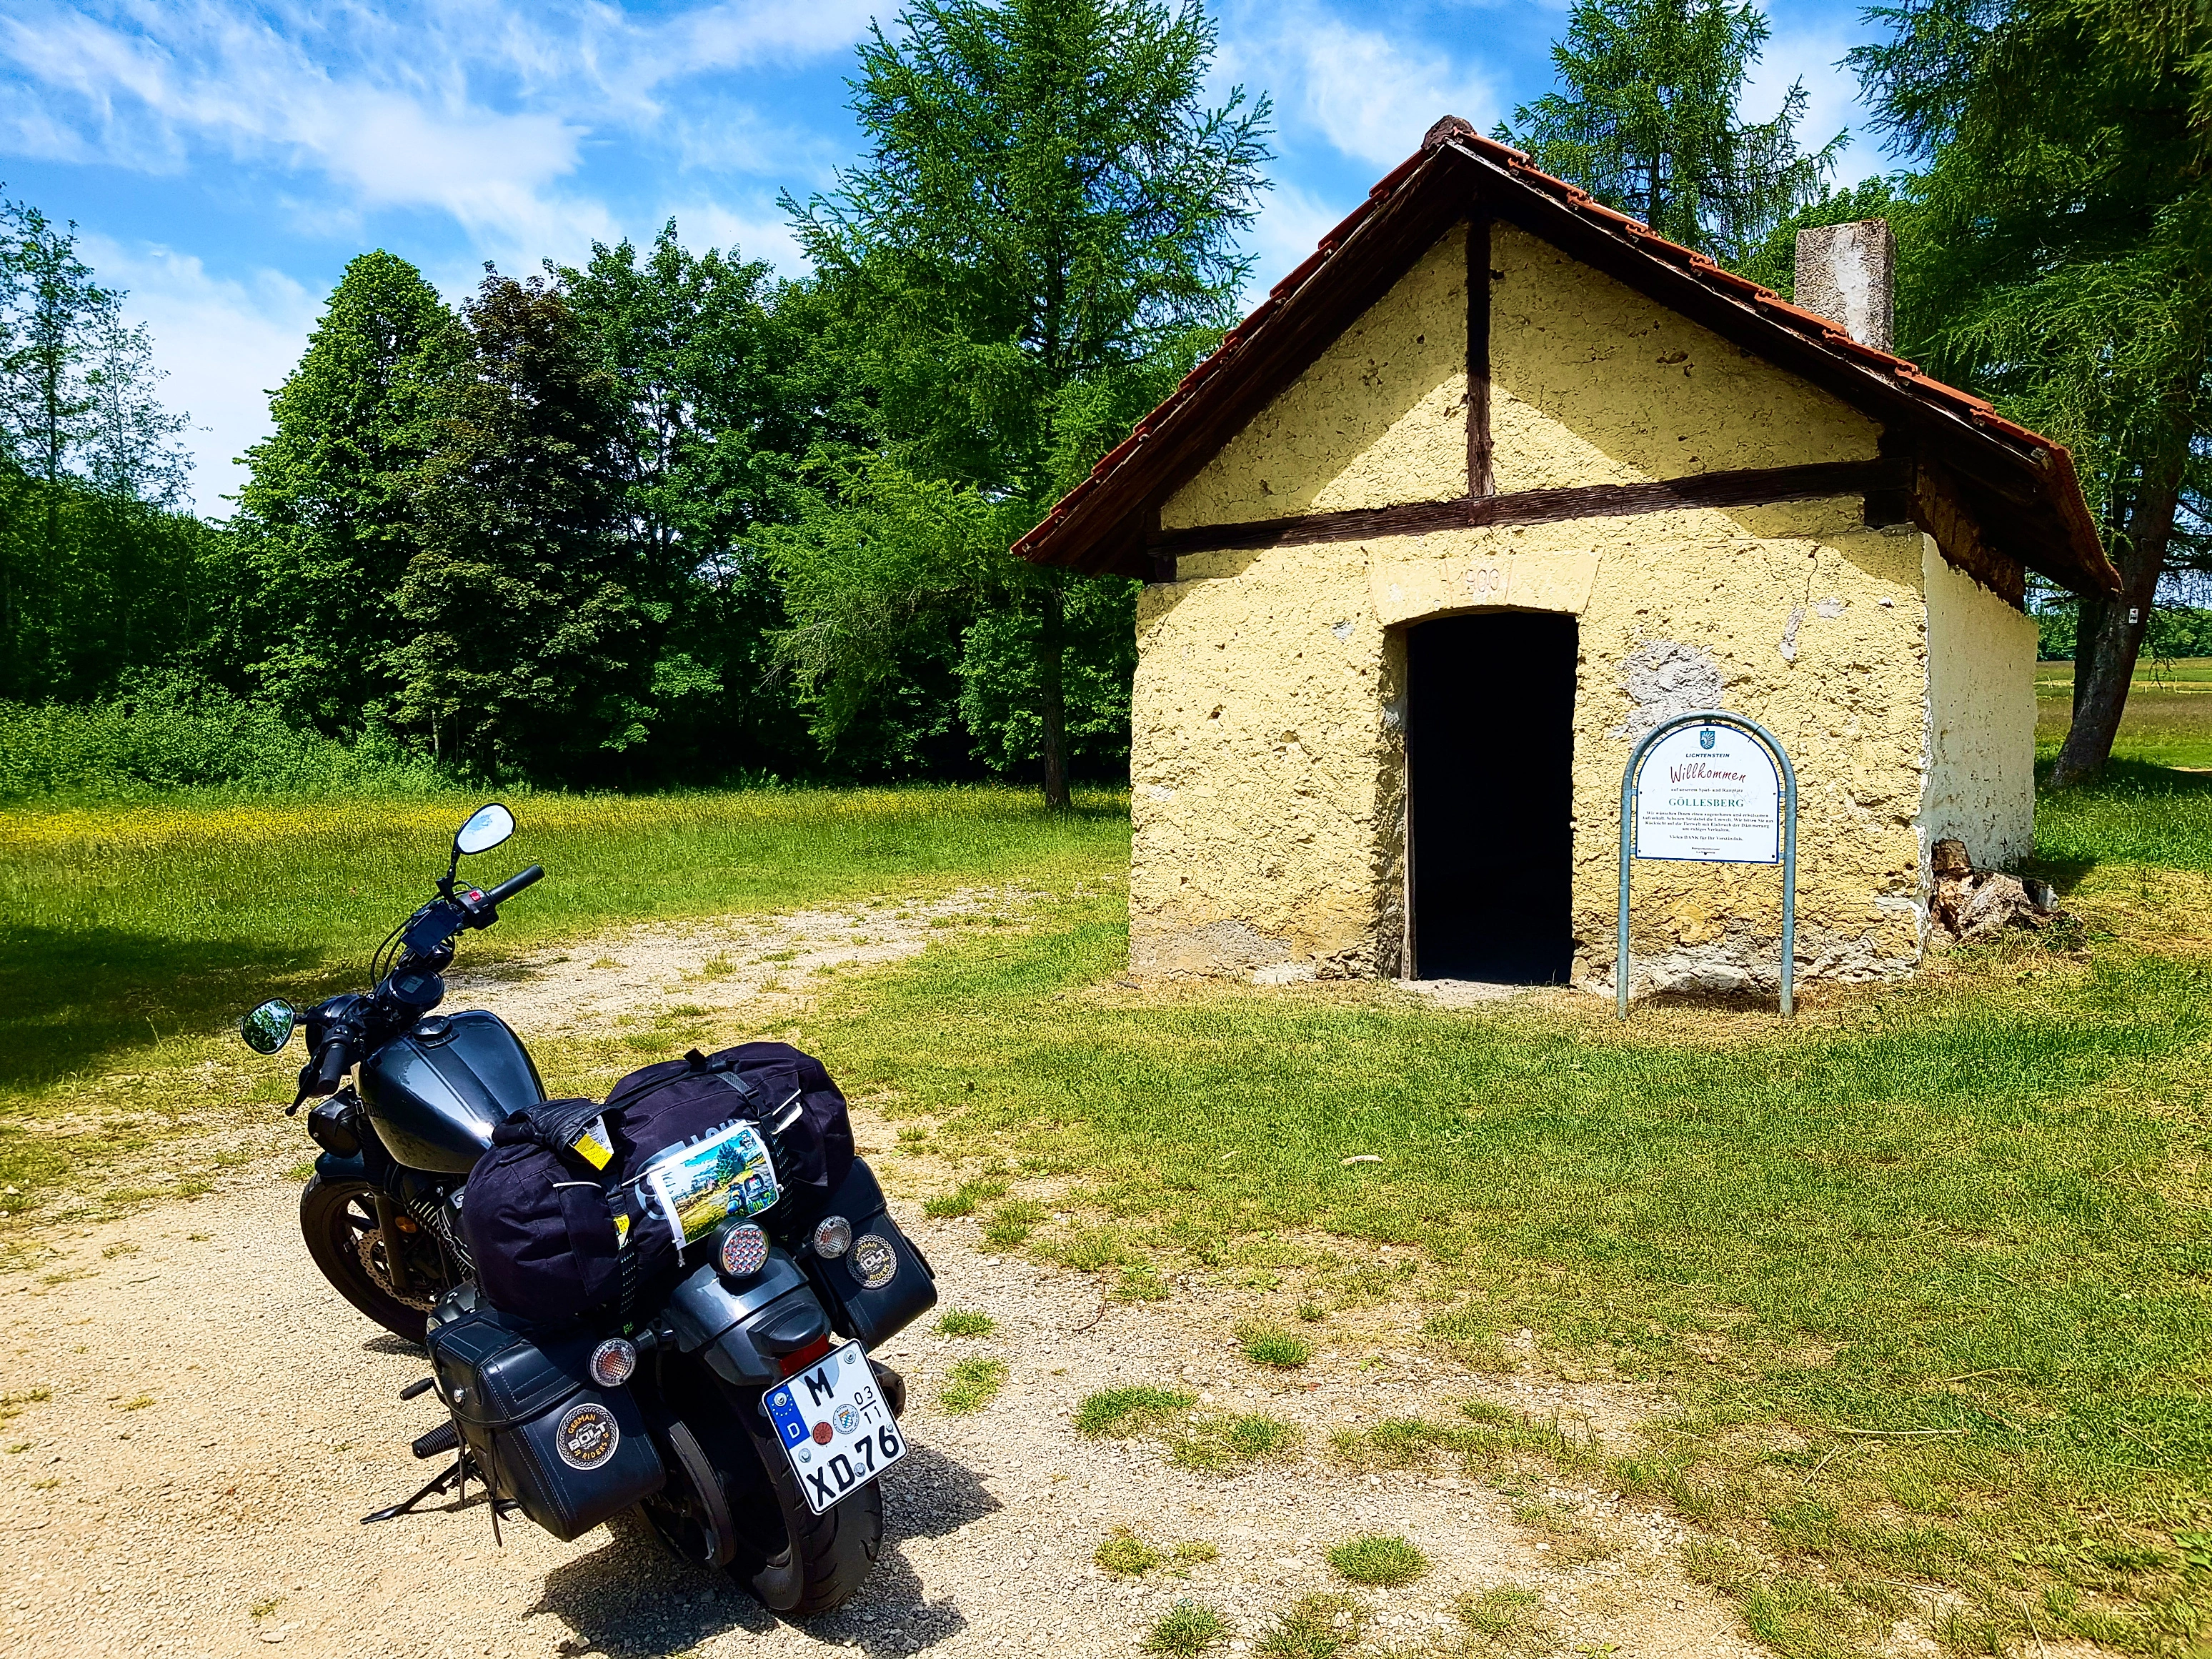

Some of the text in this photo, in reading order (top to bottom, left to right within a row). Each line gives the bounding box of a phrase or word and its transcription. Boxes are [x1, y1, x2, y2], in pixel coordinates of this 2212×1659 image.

[1670, 762, 1746, 783] Willkommen
[1668, 797, 1744, 807] GÖLLESBERG
[870, 1263, 890, 1280] RIDERS
[804, 1367, 835, 1407] M
[854, 1385, 873, 1405] 03
[567, 1413, 596, 1434] GERMAN
[864, 1405, 882, 1425] 11
[567, 1420, 607, 1452] BOLT
[787, 1422, 800, 1439] D
[582, 1441, 608, 1460] RIDERS
